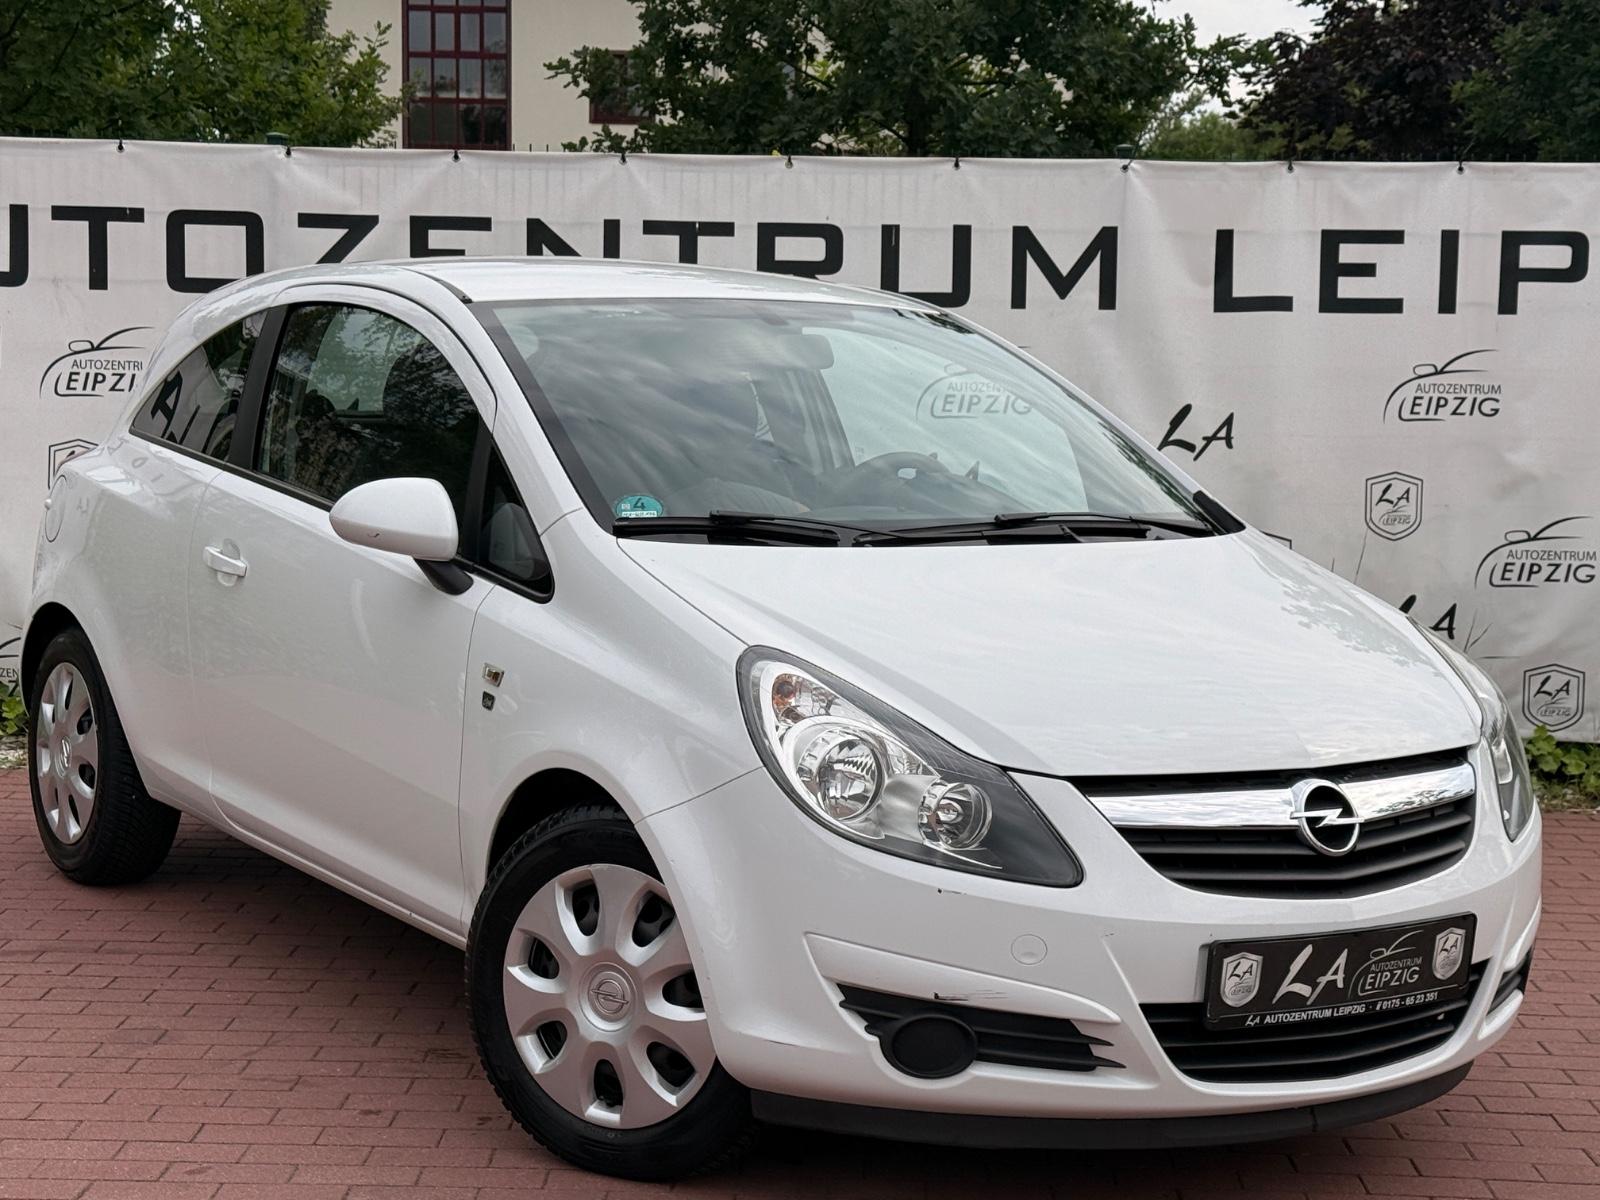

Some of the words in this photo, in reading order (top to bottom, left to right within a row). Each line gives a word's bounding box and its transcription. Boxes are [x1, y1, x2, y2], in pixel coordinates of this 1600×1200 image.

[1213, 228, 1590, 315] LEIP
[1414, 383, 1502, 395] AUTOZENTRUM
[1398, 396, 1501, 421] LEIPZIG
[1157, 403, 1234, 461] LA
[1375, 482, 1411, 508] LA
[1506, 549, 1597, 561] AUTOZENTRUM
[1489, 562, 1596, 587] LEIPZIG
[1399, 594, 1456, 640] A
[1533, 675, 1571, 700] LA
[1271, 944, 1348, 1005] LA
[1370, 956, 1423, 972] AUTOZENTRUM
[1358, 966, 1420, 996] LEIPZIG
[1263, 1008, 1332, 1025] AUTOZENTRUM
[1333, 1004, 1366, 1017] LEIPZIG
